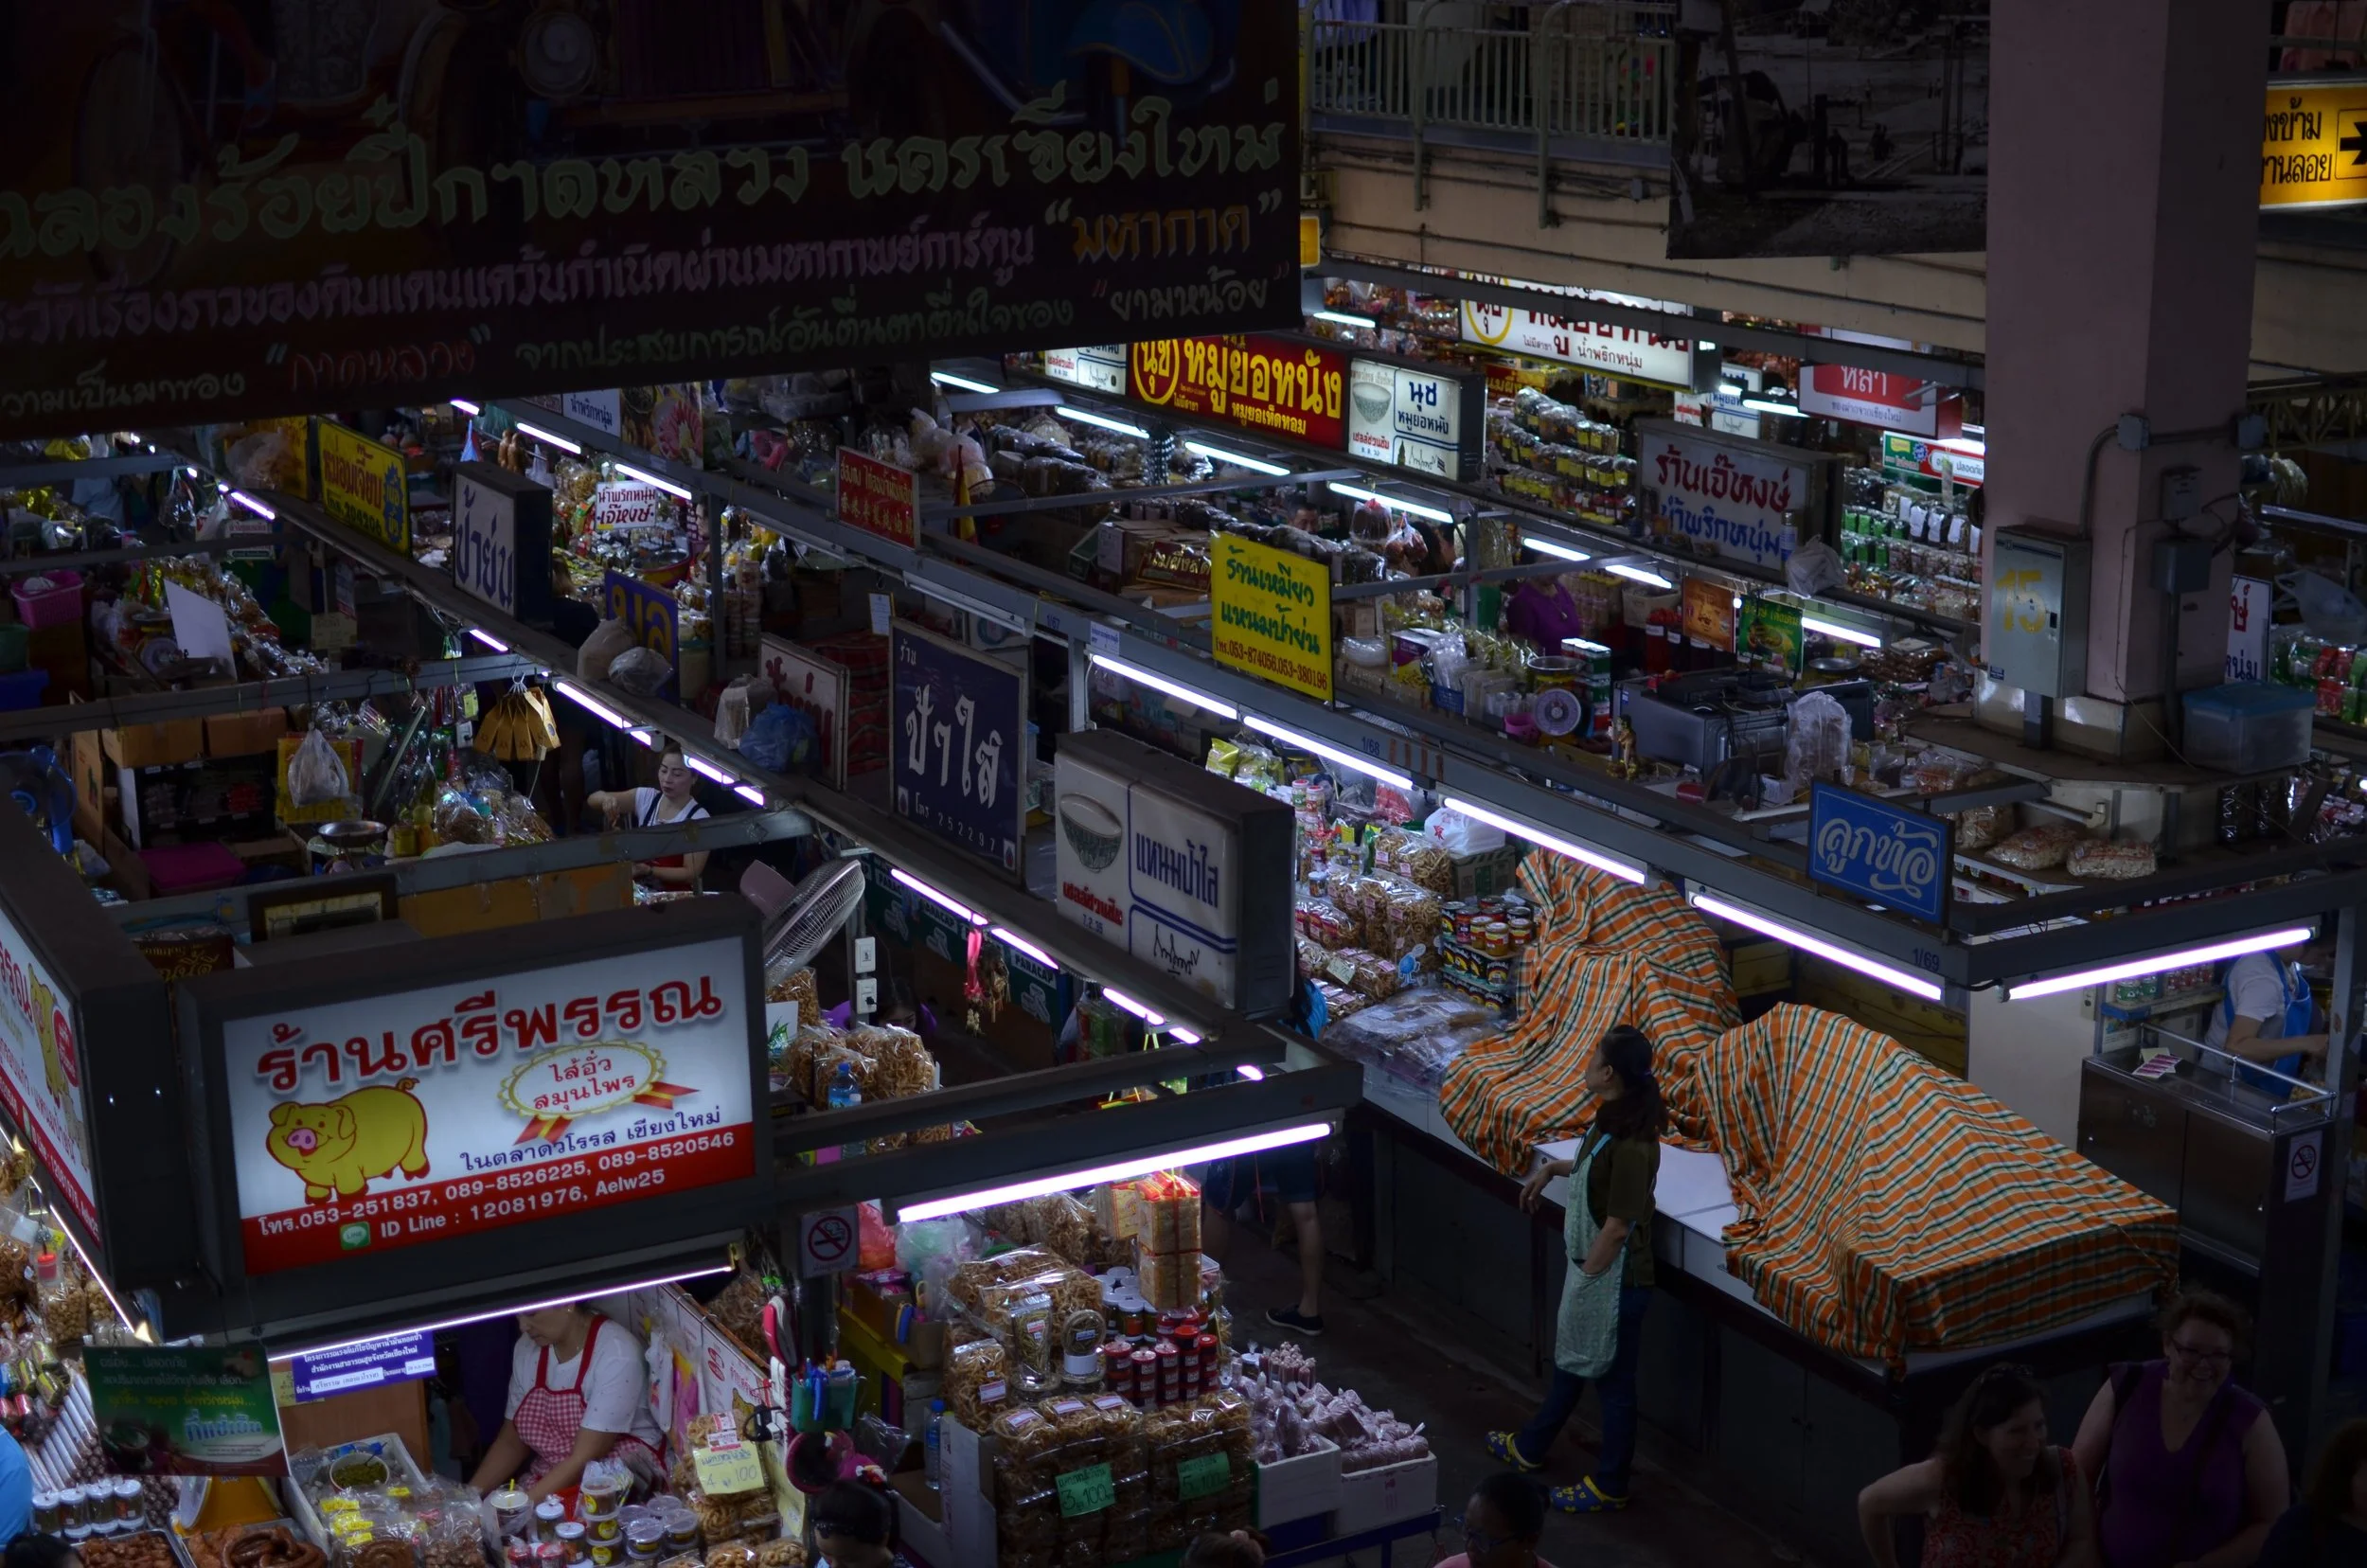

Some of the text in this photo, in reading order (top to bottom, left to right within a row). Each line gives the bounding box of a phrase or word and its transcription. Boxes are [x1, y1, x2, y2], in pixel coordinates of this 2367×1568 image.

[2264, 97, 2322, 142] งข้าม
[2261, 153, 2333, 186] านลอย
[0, 209, 1036, 344] ะวัติเรื่องราวของดินแดนแคว้นกำเนิดผ่านมหากาพย์การ์ตูน
[1996, 570, 2047, 633] 15
[256, 974, 724, 1093] ร้านศรีพรรณ
[532, 1070, 637, 1113] สมุนไพร
[549, 1049, 614, 1085] ไส้อั่ว
[444, 1156, 594, 1200] 089-8526225,
[597, 1131, 736, 1172] 089-8520546
[459, 1101, 722, 1172] ในตลาดวโรรส เชียงใหม่
[381, 1221, 401, 1239] ID
[408, 1209, 448, 1233] Line
[470, 1184, 590, 1221] 12081976,
